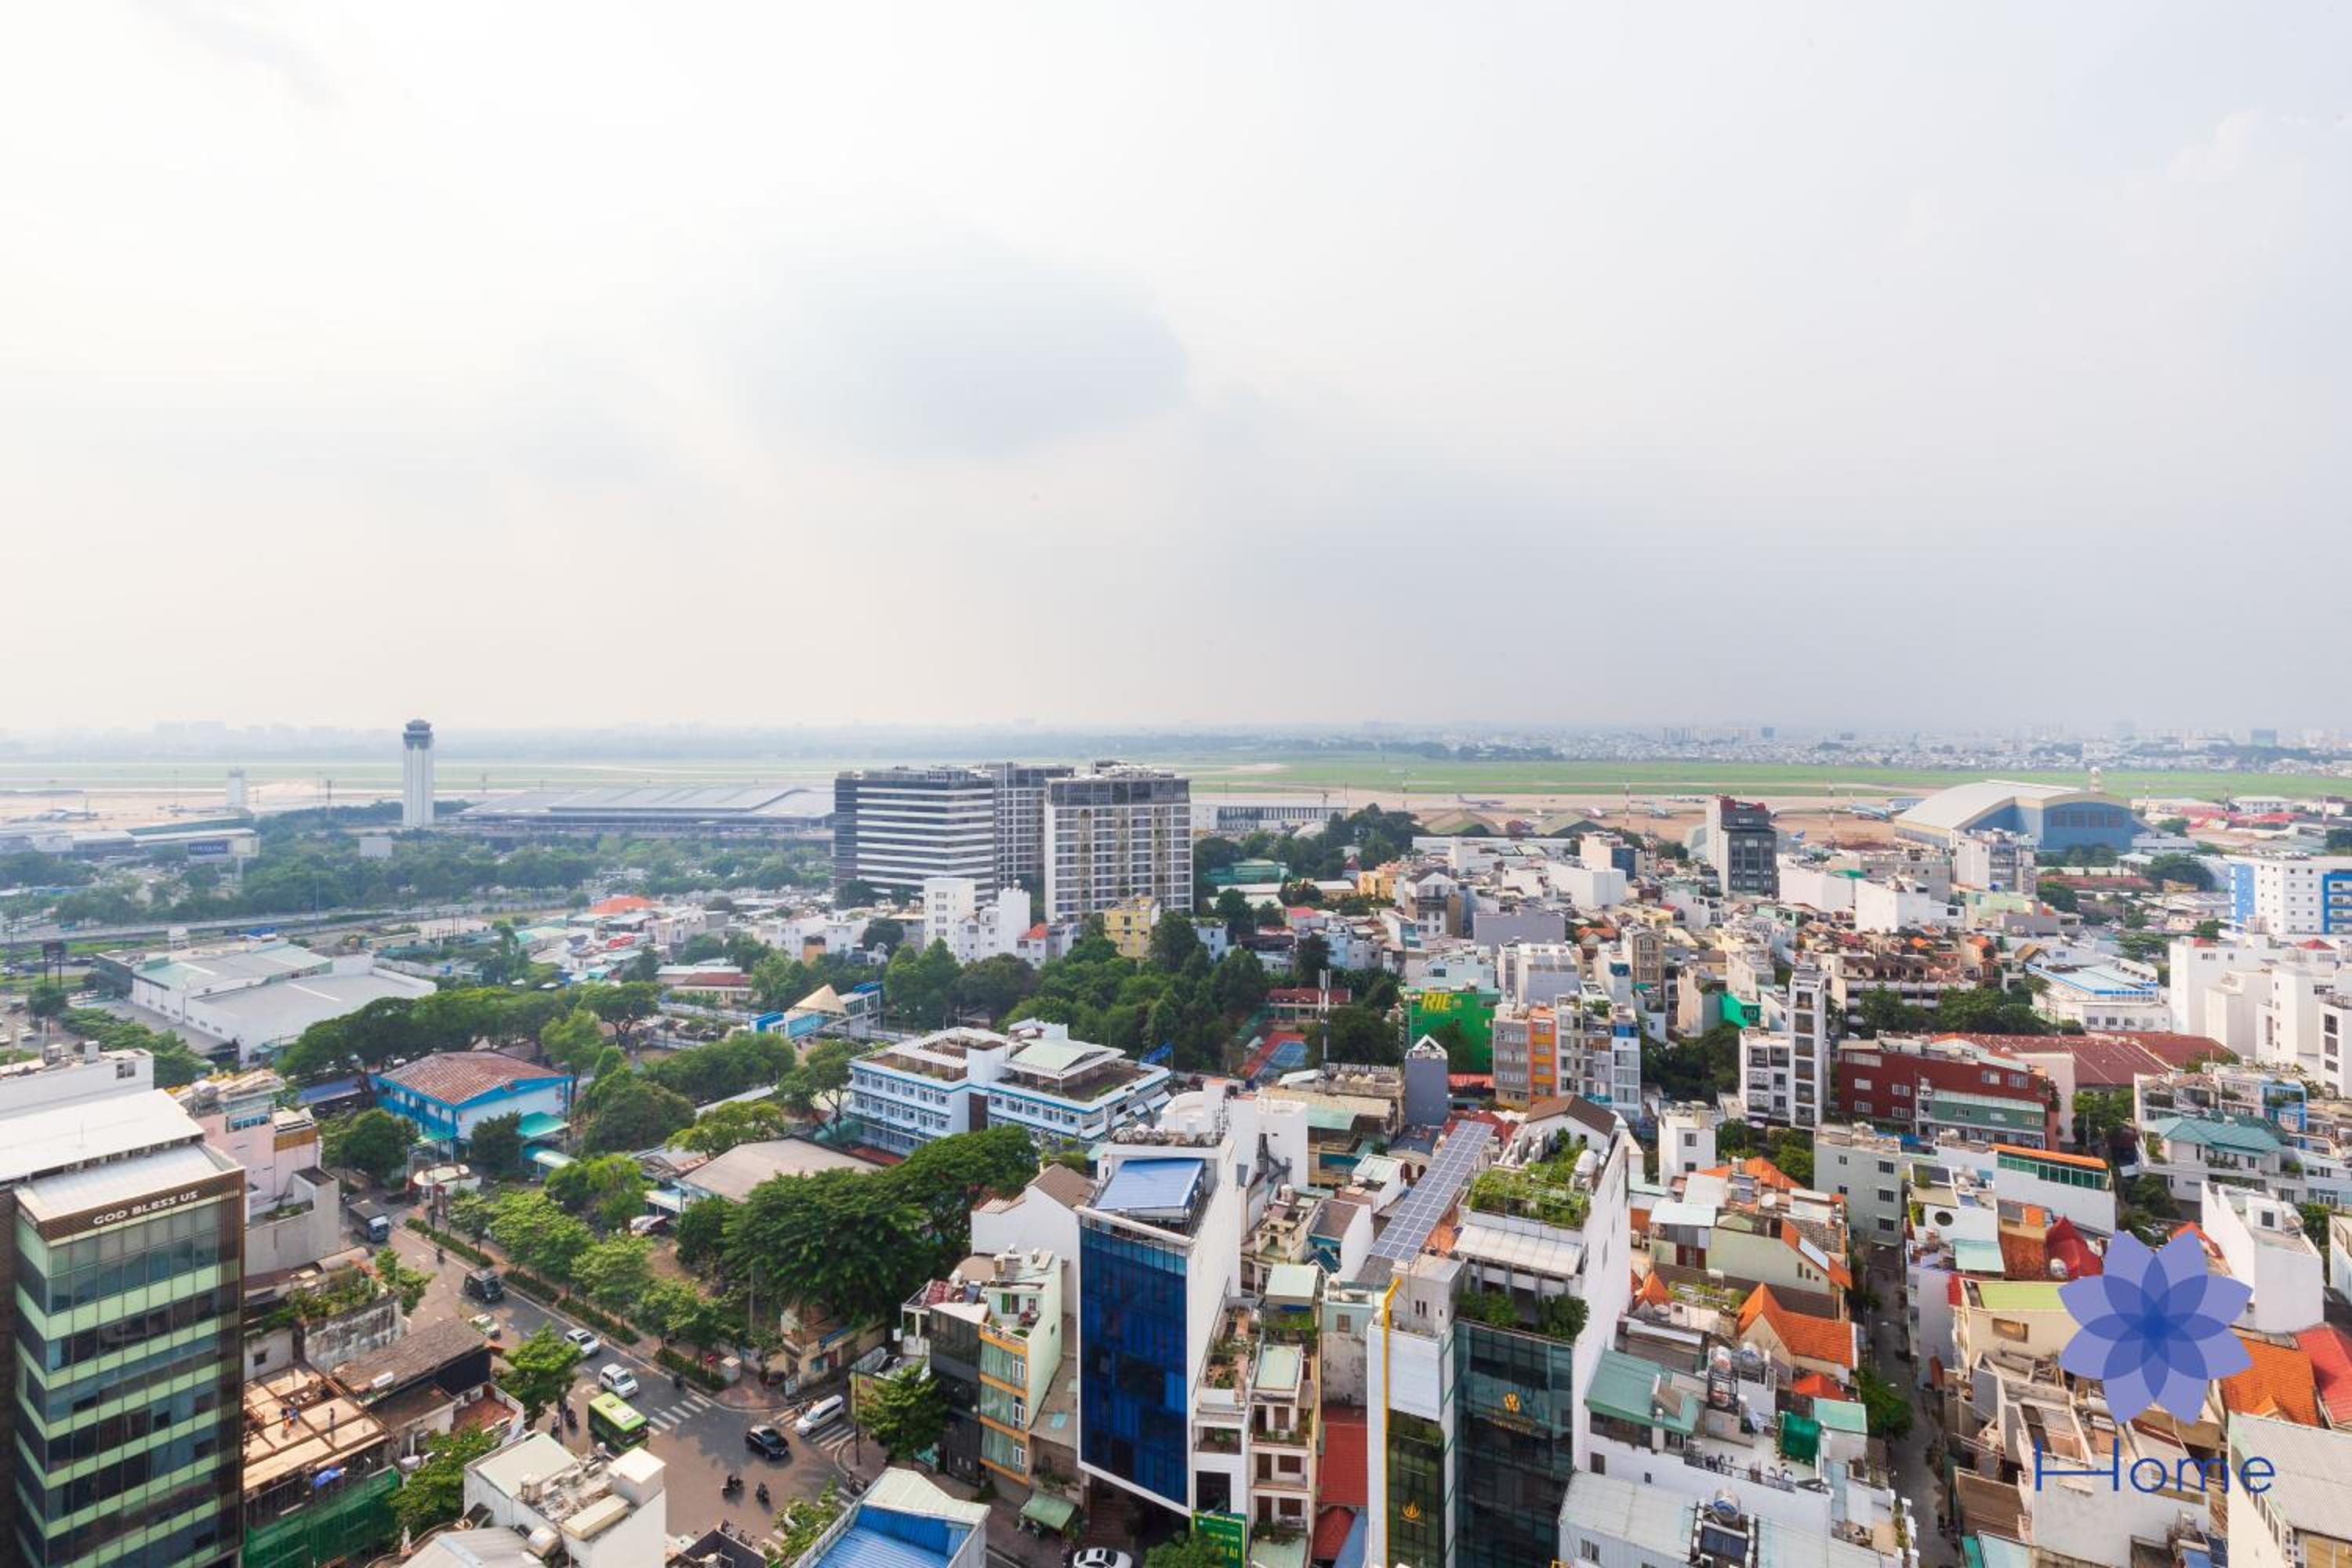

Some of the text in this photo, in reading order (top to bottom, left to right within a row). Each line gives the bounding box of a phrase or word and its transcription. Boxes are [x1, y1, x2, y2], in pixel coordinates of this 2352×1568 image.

[93, 1190, 198, 1225] GOD BLESS US
